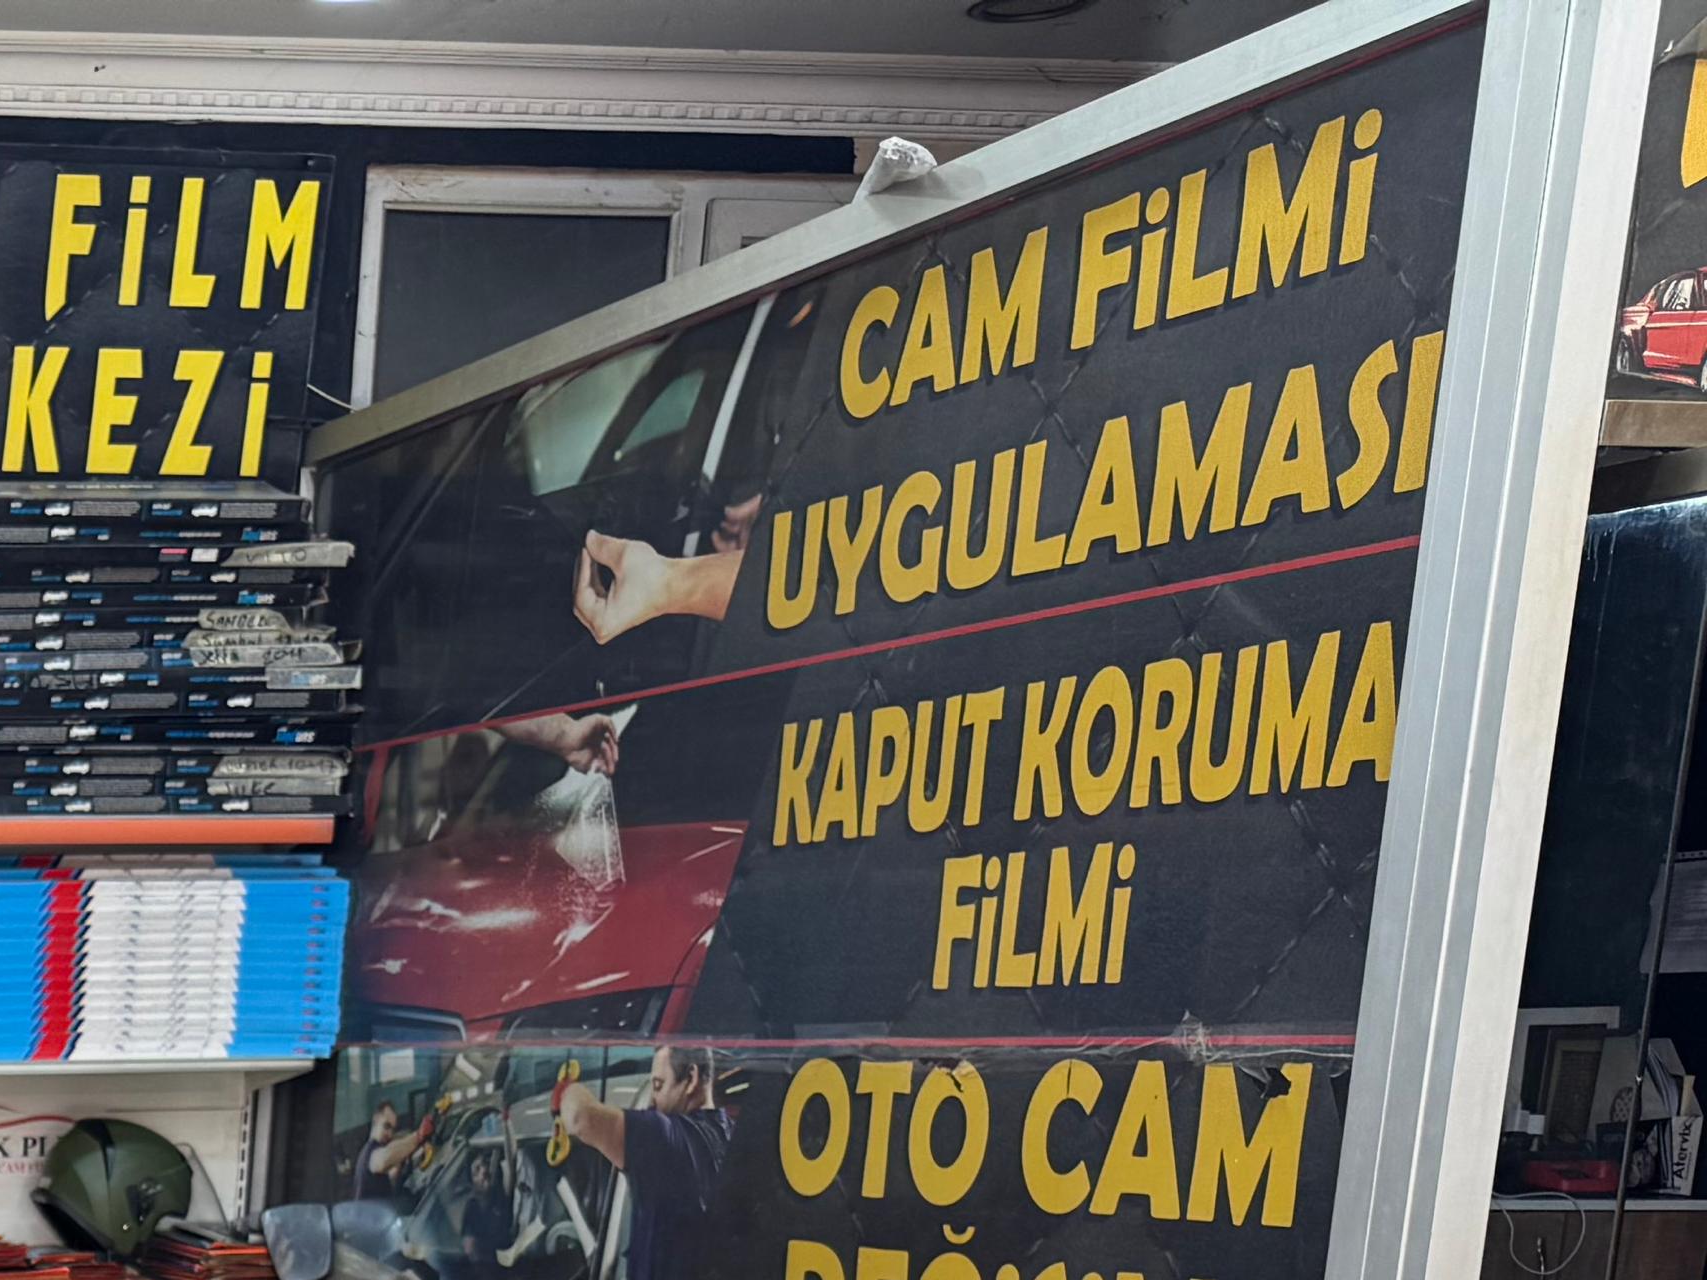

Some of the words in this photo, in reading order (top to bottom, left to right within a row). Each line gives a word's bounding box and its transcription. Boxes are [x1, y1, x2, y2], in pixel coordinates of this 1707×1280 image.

[839, 226, 1048, 419] CAM
[766, 331, 1444, 630] UYGULAMASI
[772, 687, 1005, 846] KAPUT
[1013, 621, 1397, 822] KORUMA
[779, 1058, 989, 1206] OTO
[1021, 1059, 1313, 1228] CAM
